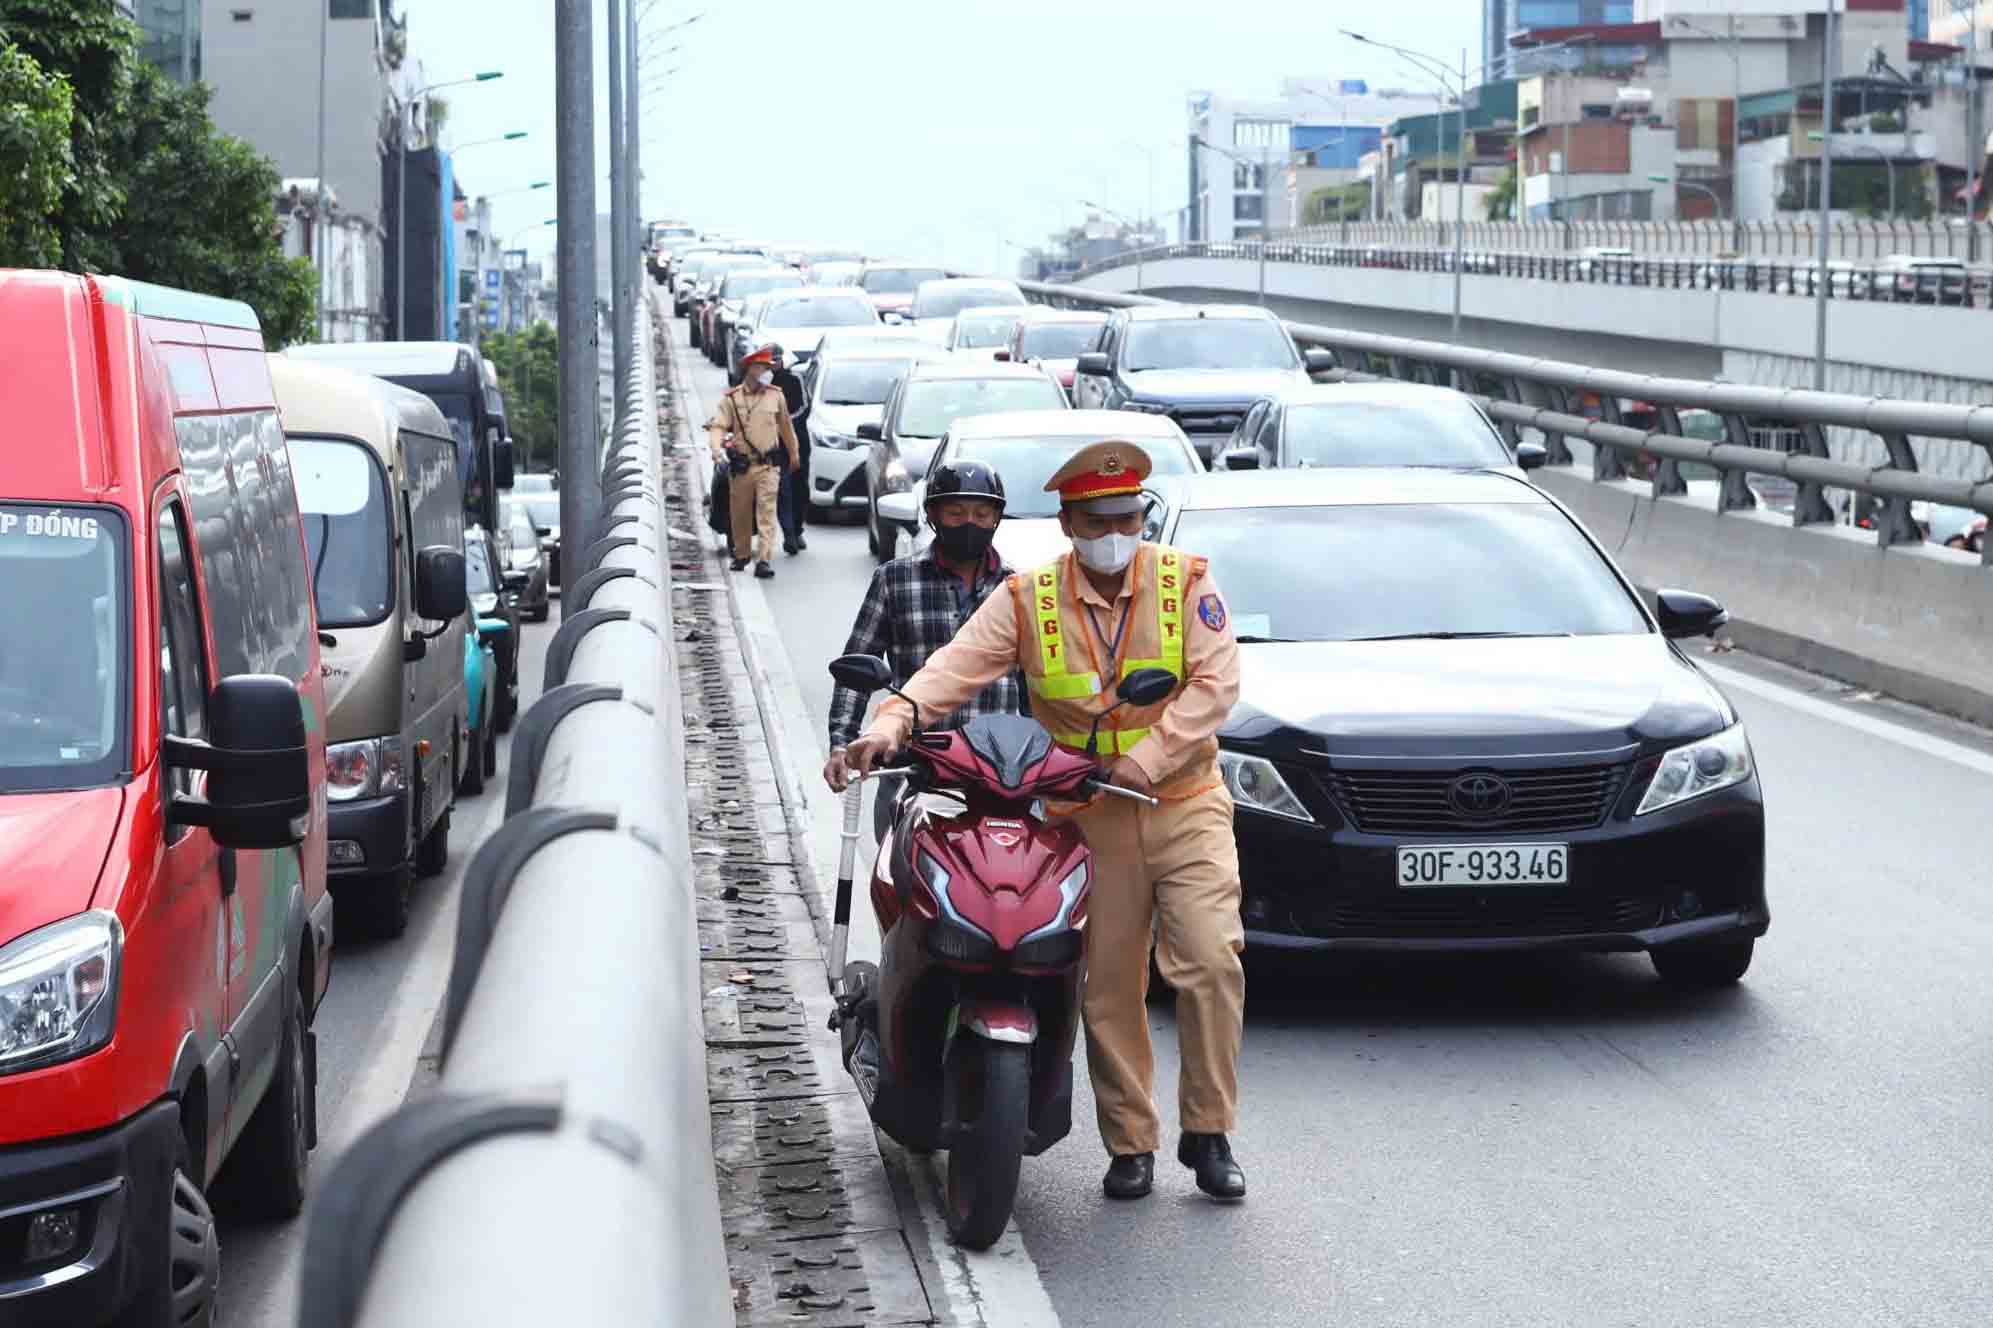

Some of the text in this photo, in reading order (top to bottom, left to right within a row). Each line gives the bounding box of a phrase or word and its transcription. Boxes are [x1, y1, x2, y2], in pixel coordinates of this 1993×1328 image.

[1038, 573, 1058, 659] CSGT
[1162, 554, 1178, 638] CSGT
[1402, 849, 1563, 882] 30F-933.46
